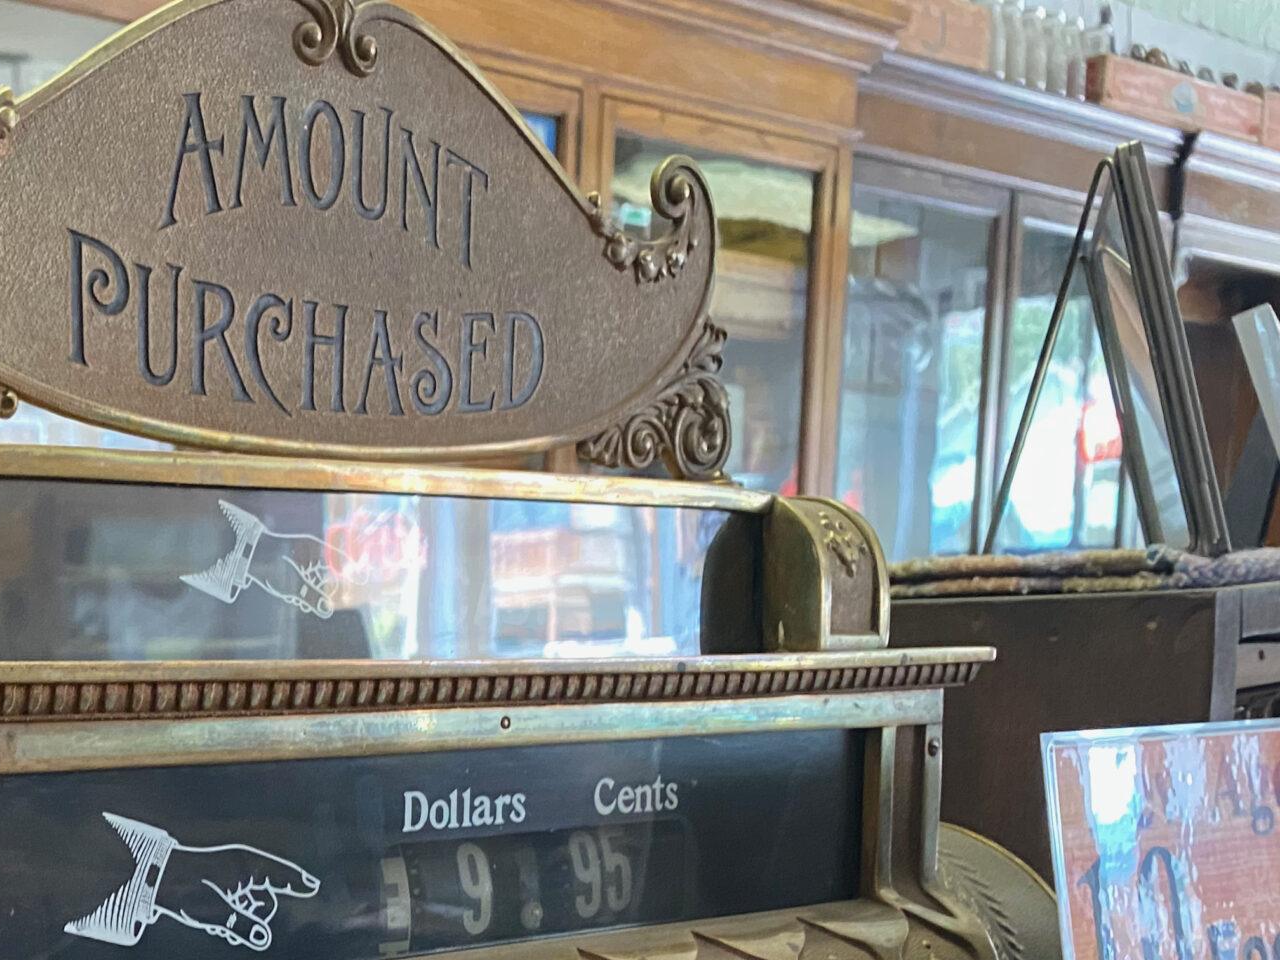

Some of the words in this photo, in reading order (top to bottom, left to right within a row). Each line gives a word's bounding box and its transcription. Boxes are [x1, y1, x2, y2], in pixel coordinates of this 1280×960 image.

[159, 92, 489, 269] AMOUNT
[67, 228, 544, 417] PURCHASED
[402, 788, 526, 833] Dollars
[594, 776, 678, 816] Cents
[457, 843, 493, 935] 9
[569, 830, 632, 918] 95
